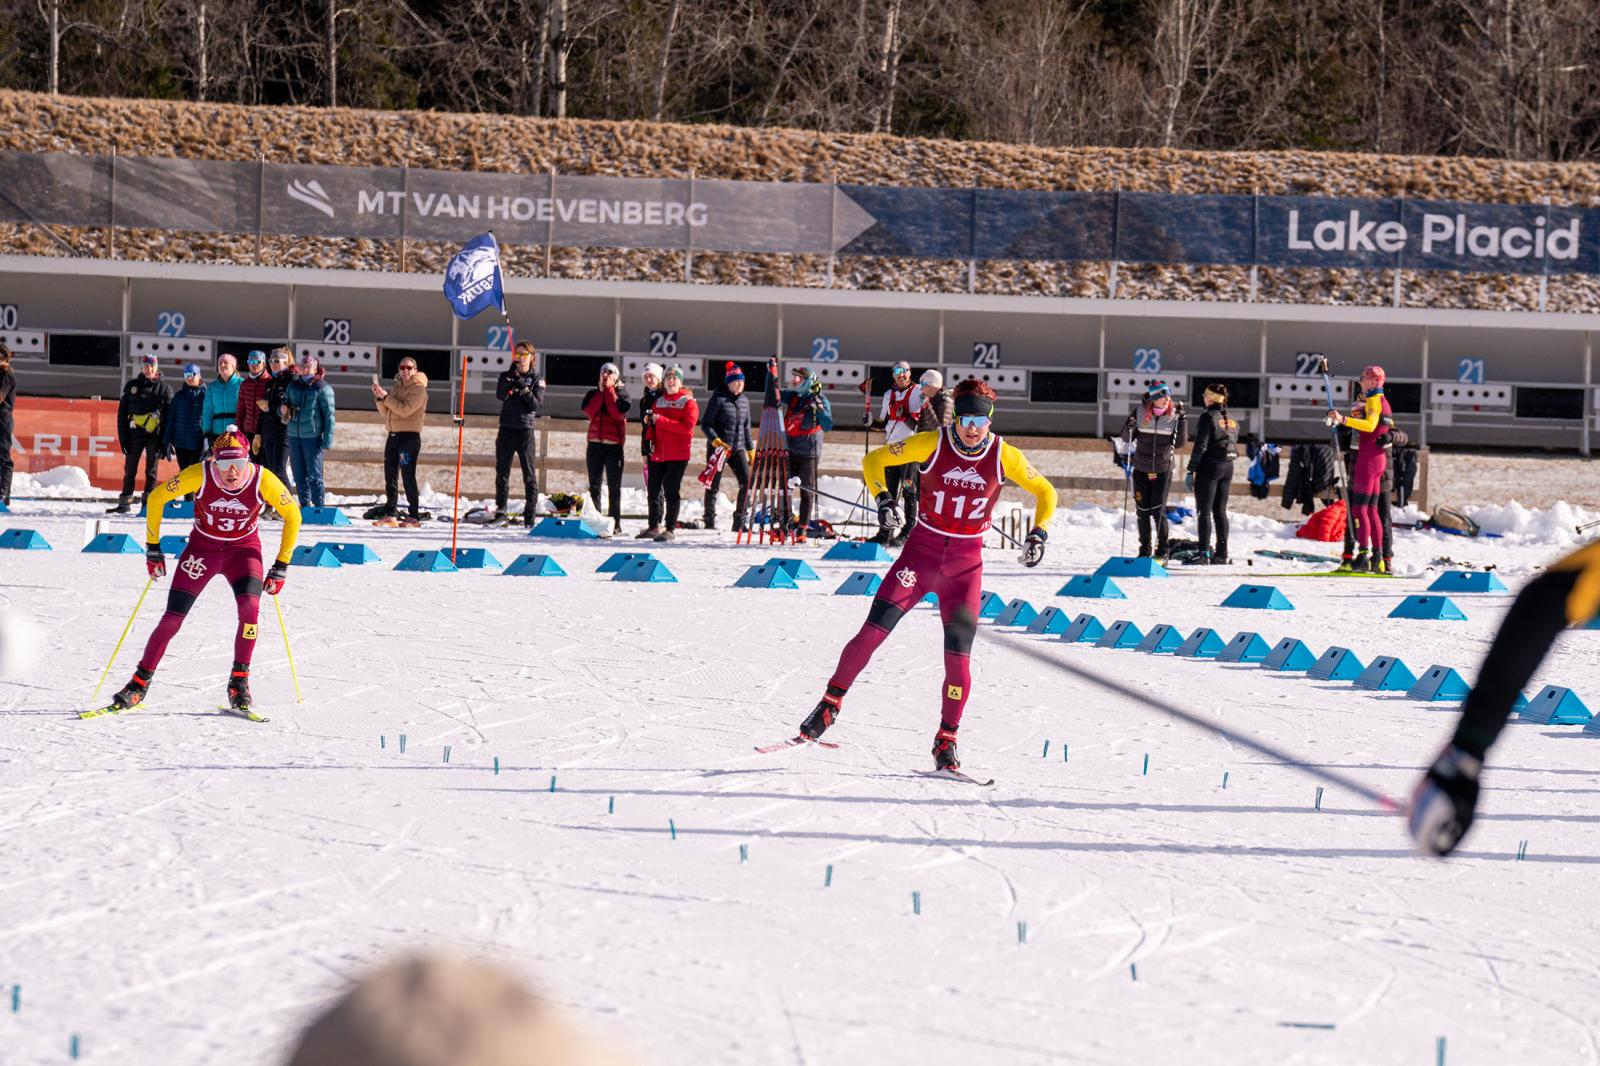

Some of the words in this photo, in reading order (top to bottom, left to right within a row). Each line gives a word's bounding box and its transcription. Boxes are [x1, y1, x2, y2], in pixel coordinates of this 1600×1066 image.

[358, 190, 404, 216] MT
[412, 191, 480, 219] VAN
[487, 197, 709, 227] HOEVENBERG
[1288, 209, 1407, 252] Lake
[1422, 213, 1580, 259] Placid
[0, 305, 17, 330] 0
[158, 312, 186, 335] 29
[324, 319, 350, 343] 28
[487, 325, 514, 350] 27
[650, 332, 677, 356] 26
[812, 338, 839, 362] 25
[973, 344, 1000, 368] 24
[1135, 349, 1161, 373] 23
[1296, 353, 1321, 377] 22
[1459, 359, 1484, 382] 21
[942, 478, 985, 491] USCSA
[210, 506, 248, 515] USCSA
[933, 490, 988, 520] 112
[204, 511, 249, 532] 137
